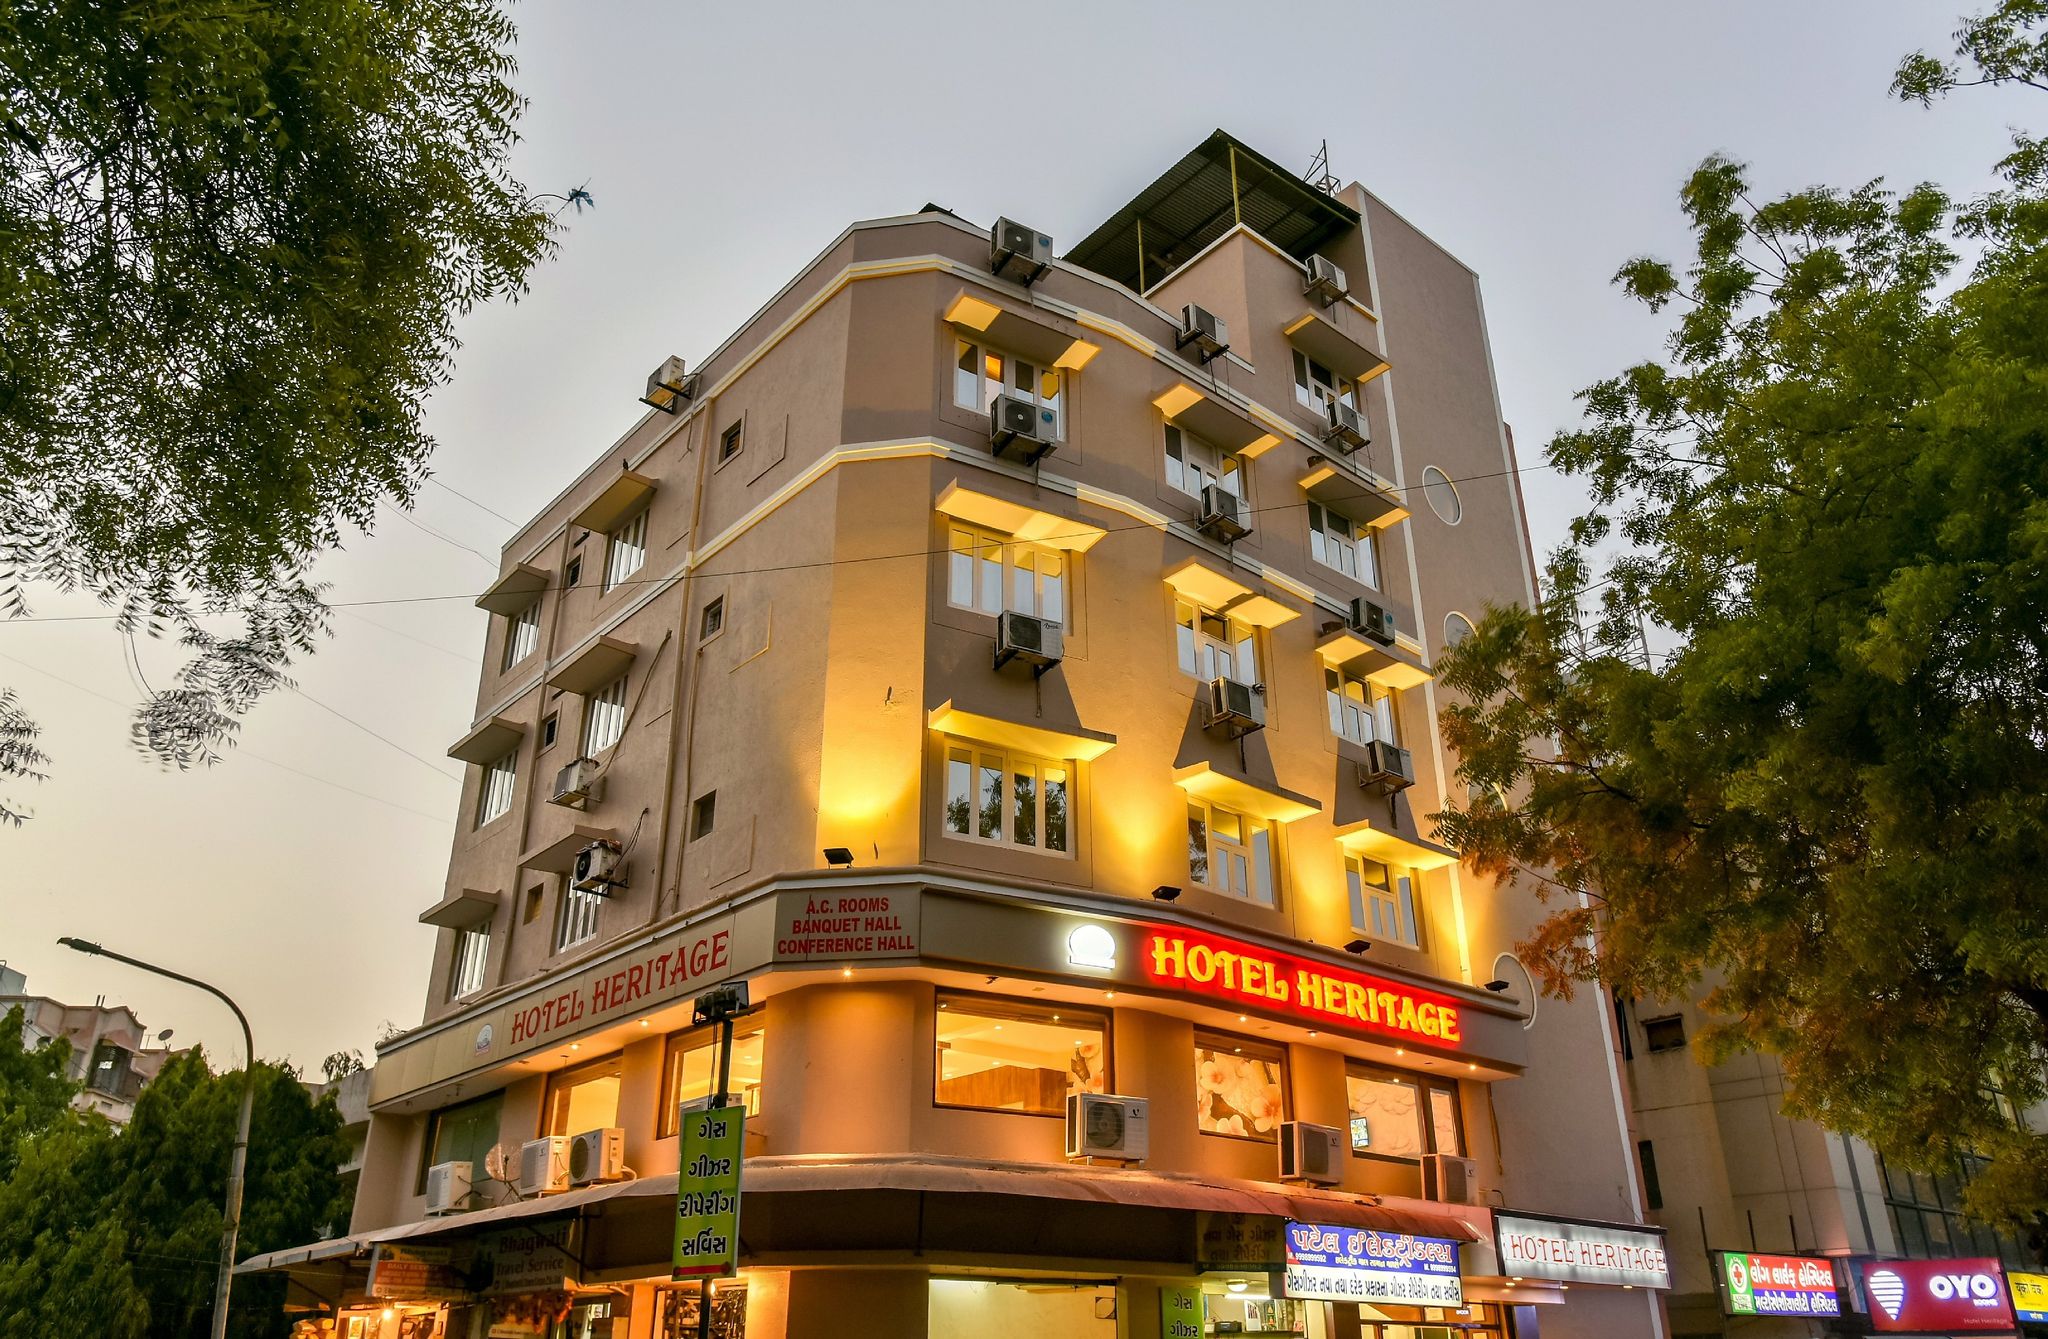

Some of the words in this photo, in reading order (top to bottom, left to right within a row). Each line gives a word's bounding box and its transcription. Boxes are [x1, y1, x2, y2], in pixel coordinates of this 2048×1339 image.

[806, 899, 833, 914] A.C.
[839, 897, 889, 913] ROOMS
[792, 917, 861, 934] BANQUET
[864, 915, 902, 931] HALL
[777, 936, 873, 955] CONFERENCE
[877, 935, 915, 951] HALL
[510, 989, 585, 1046] HOTEL
[591, 929, 730, 1016] HERITAGE
[1151, 936, 1290, 1002] HOTEL
[1296, 969, 1461, 1042] HERITAGE
[698, 1116, 727, 1139] ગેસ
[688, 1153, 731, 1178] ગીઝર
[679, 1189, 735, 1217] રીપેરીંગ
[681, 1227, 727, 1256] સર્વિસ
[1291, 1224, 1339, 1253] પટેલ
[1511, 1235, 1575, 1263] HOTEL
[1580, 1241, 1666, 1272] HERITAGE
[1929, 1274, 1997, 1299] OYO
[1174, 1293, 1193, 1310] ગેસ
[1169, 1320, 1199, 1337] ગીઝર
